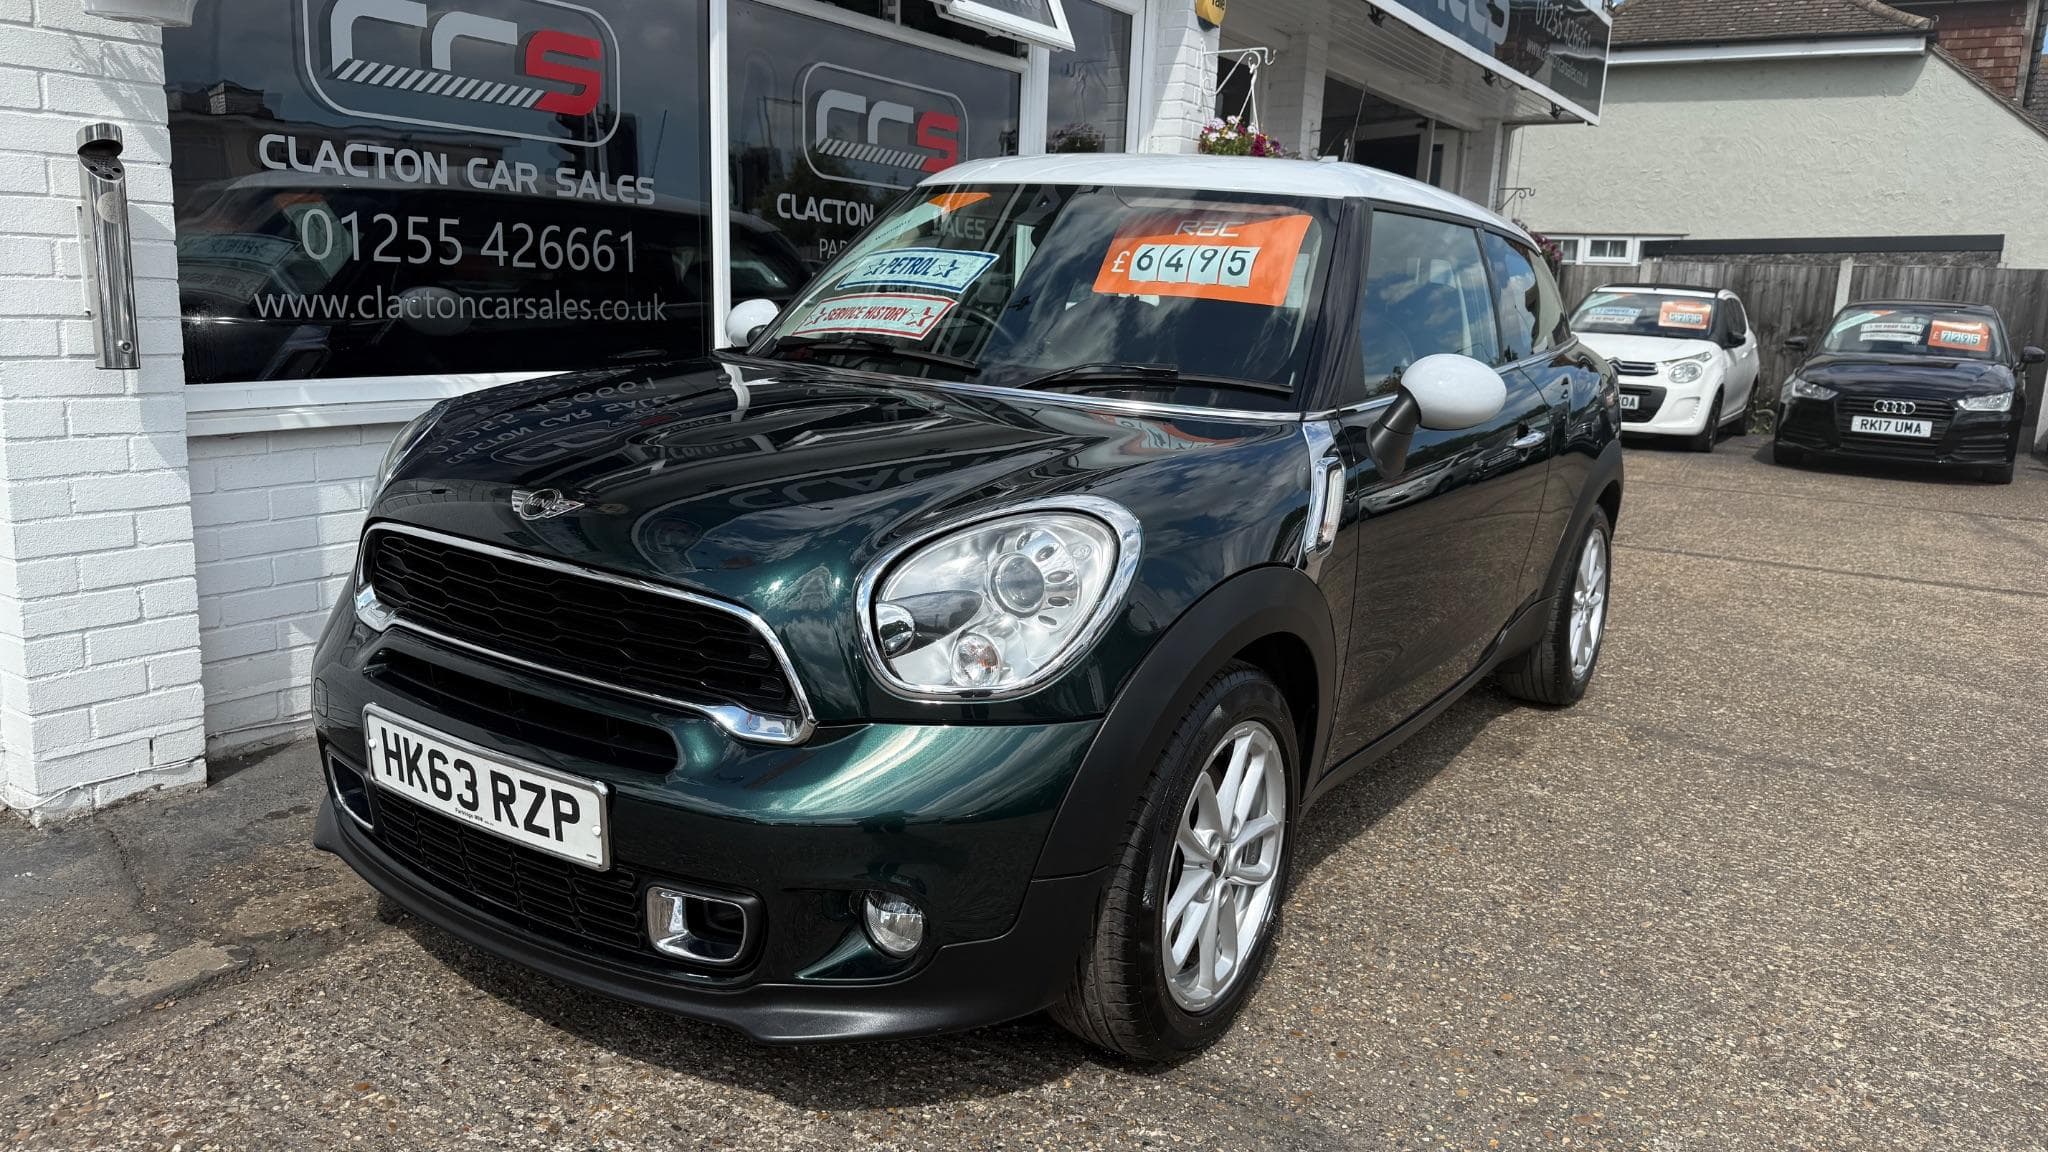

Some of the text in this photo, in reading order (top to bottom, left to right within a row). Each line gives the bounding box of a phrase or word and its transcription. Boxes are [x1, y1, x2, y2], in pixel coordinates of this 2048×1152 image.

[815, 88, 960, 172] CCS
[258, 133, 656, 205] CLACTON CAR SALES
[776, 193, 874, 227] CLACTON
[301, 208, 463, 267] 01255
[480, 221, 636, 274] 426661
[881, 256, 939, 276] PETROL
[254, 286, 668, 323] www.clactoncarsales.co.uk
[823, 305, 913, 322] SERVICE HISTORY
[1619, 396, 1635, 408] OA
[1860, 419, 1922, 435] RK17 UMA
[381, 726, 581, 842] HK63 RZP
